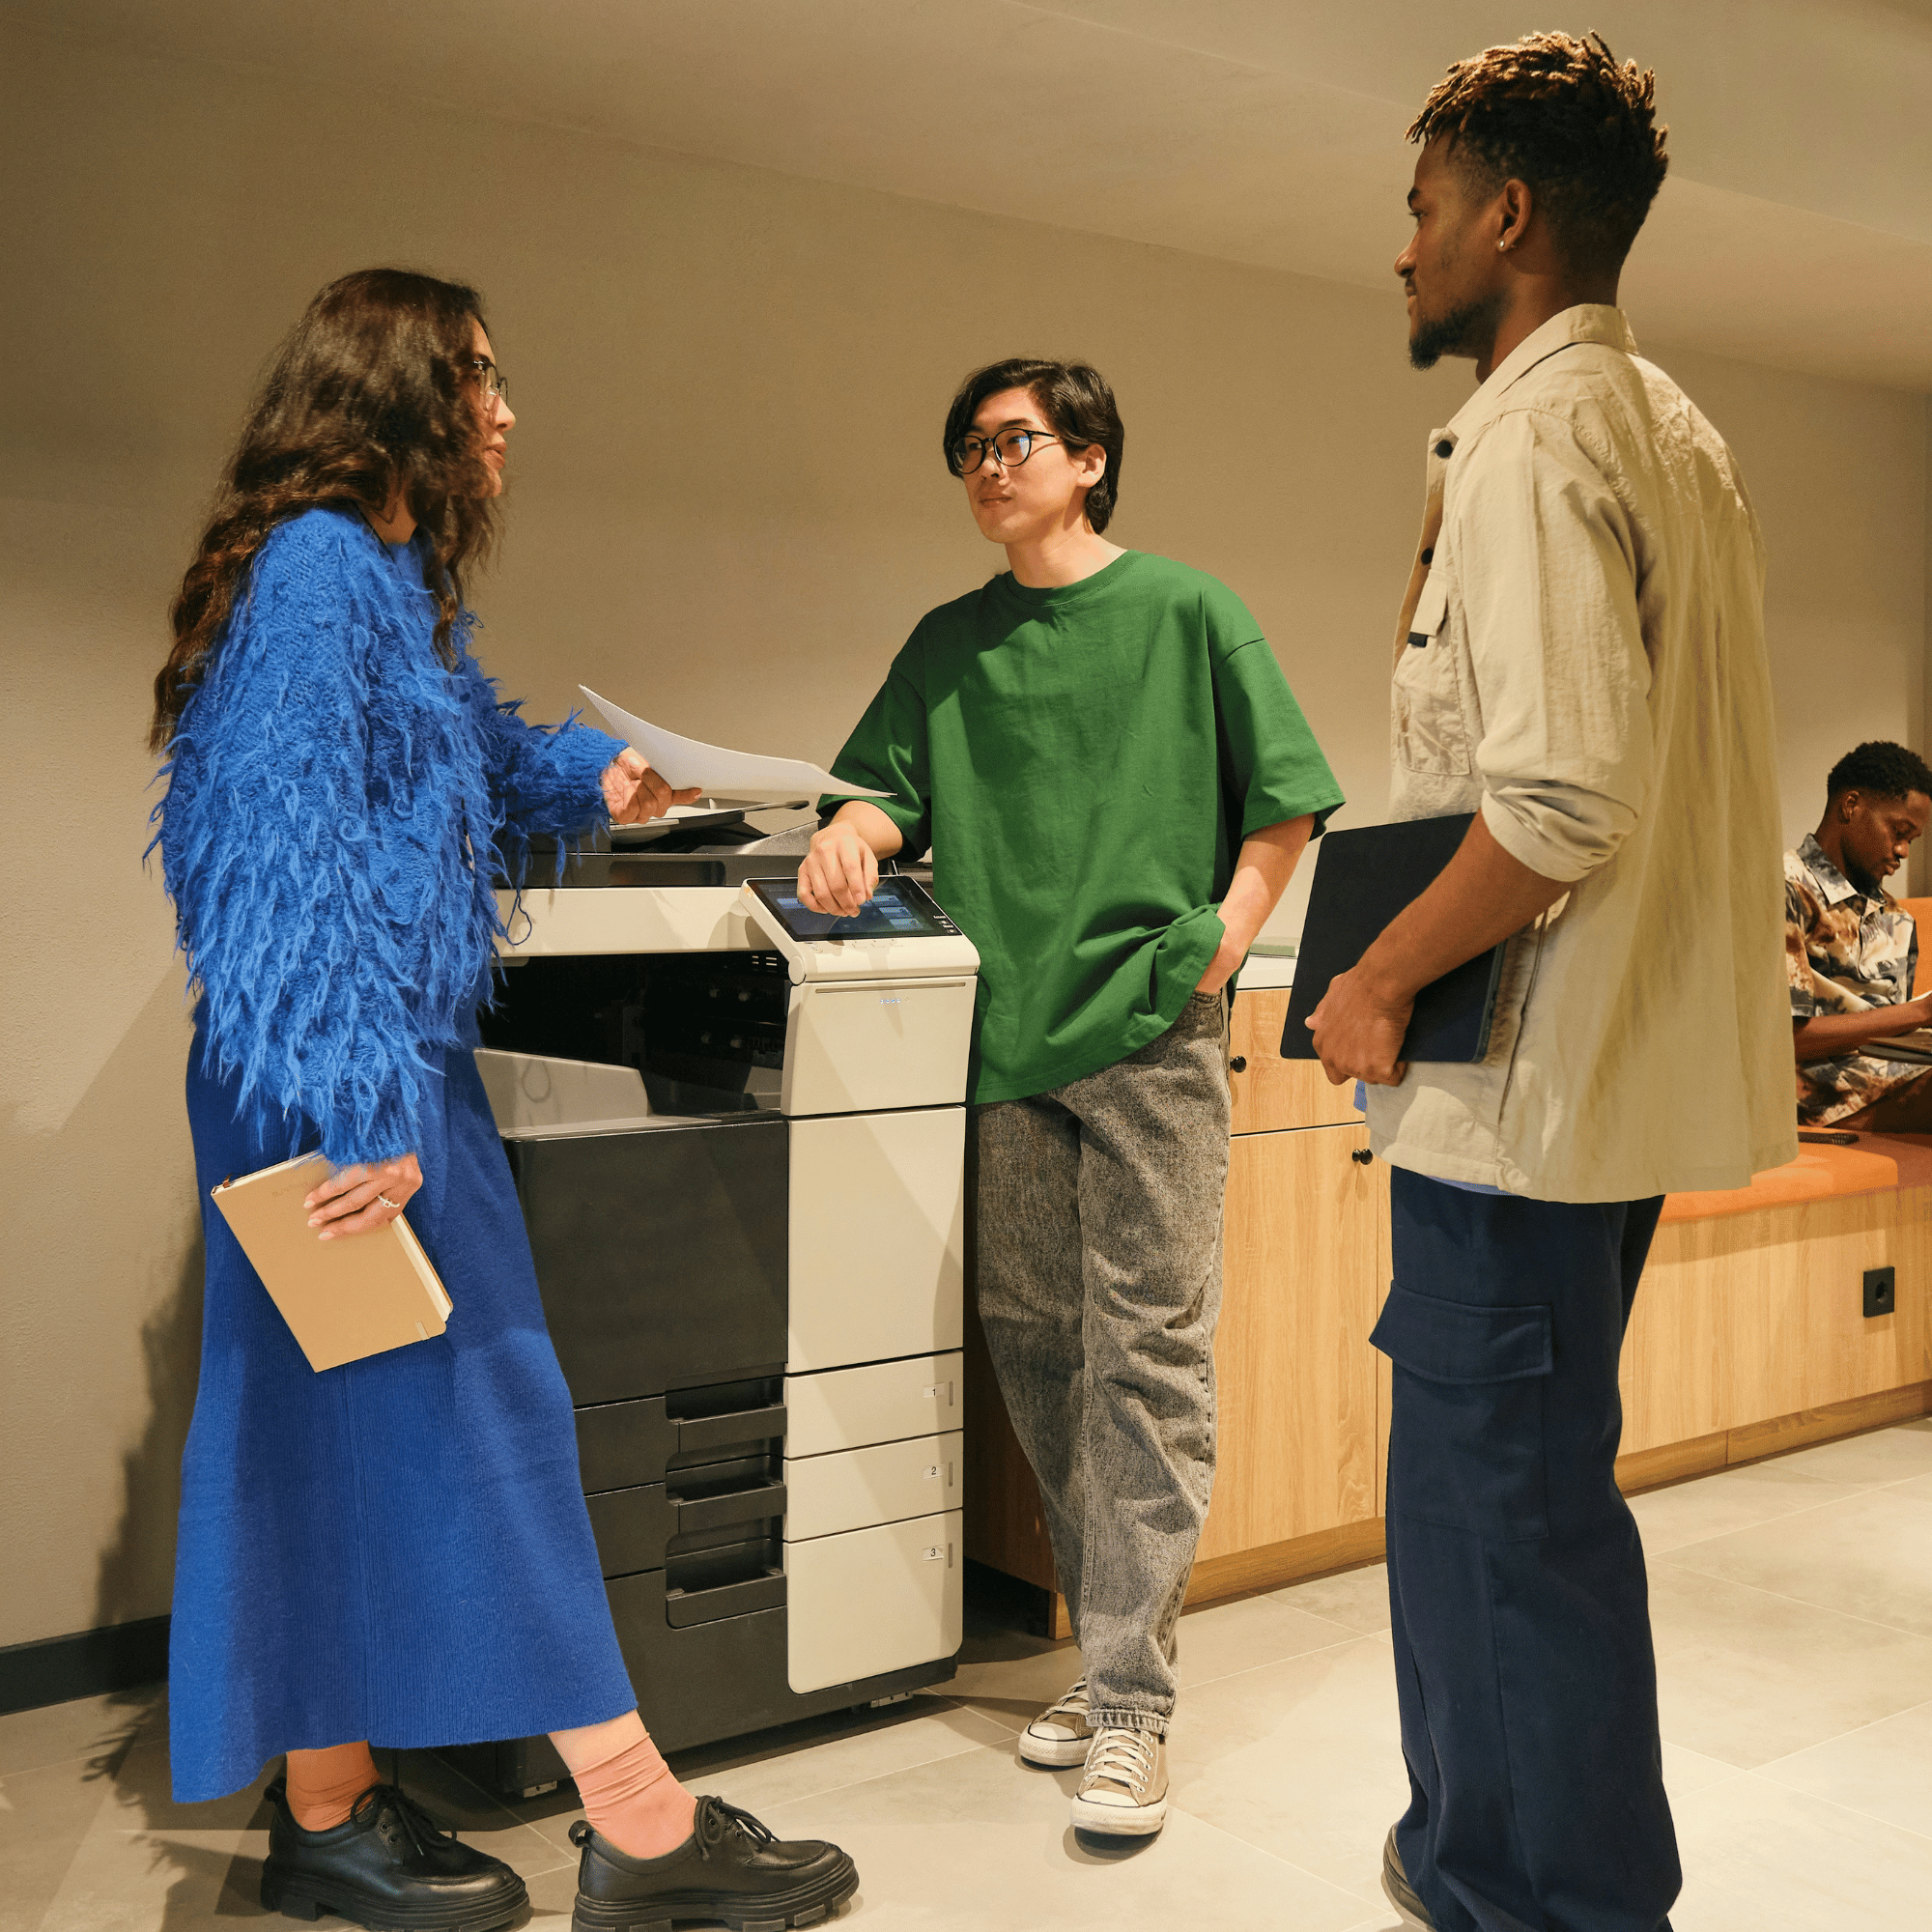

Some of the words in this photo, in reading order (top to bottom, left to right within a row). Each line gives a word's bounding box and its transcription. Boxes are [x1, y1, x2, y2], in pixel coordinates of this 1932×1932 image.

[931, 1387, 936, 1397] 1
[930, 1465, 937, 1475] 2
[929, 1548, 936, 1557] 3
